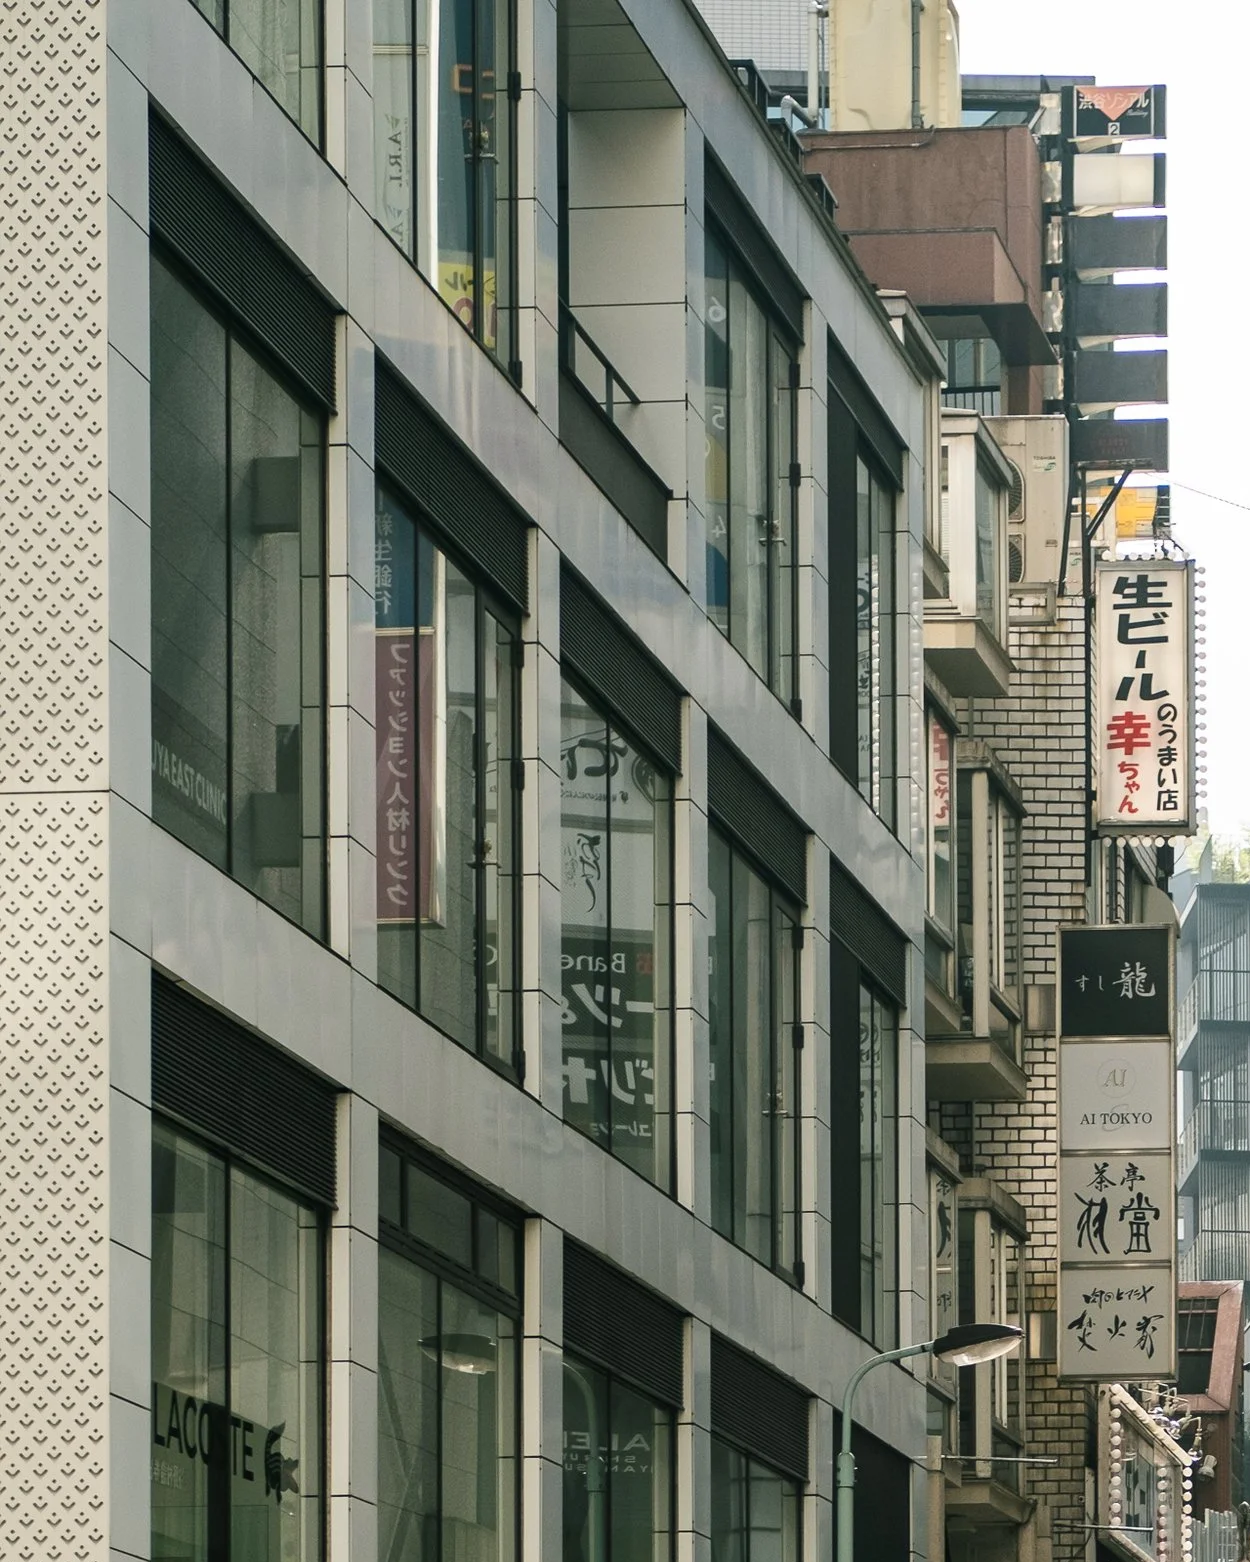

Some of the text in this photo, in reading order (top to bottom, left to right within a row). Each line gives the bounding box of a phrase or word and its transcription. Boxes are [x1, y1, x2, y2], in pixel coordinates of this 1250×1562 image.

[1109, 123, 1118, 135] 2
[1112, 574, 1173, 701] 生ビール
[1157, 703, 1178, 811] のうまい店
[1106, 711, 1151, 814] 幸ちゃん
[1112, 962, 1156, 999] 龍
[1080, 1112, 1153, 1125] AI TOKYO
[154, 1382, 255, 1482] LACOTE
